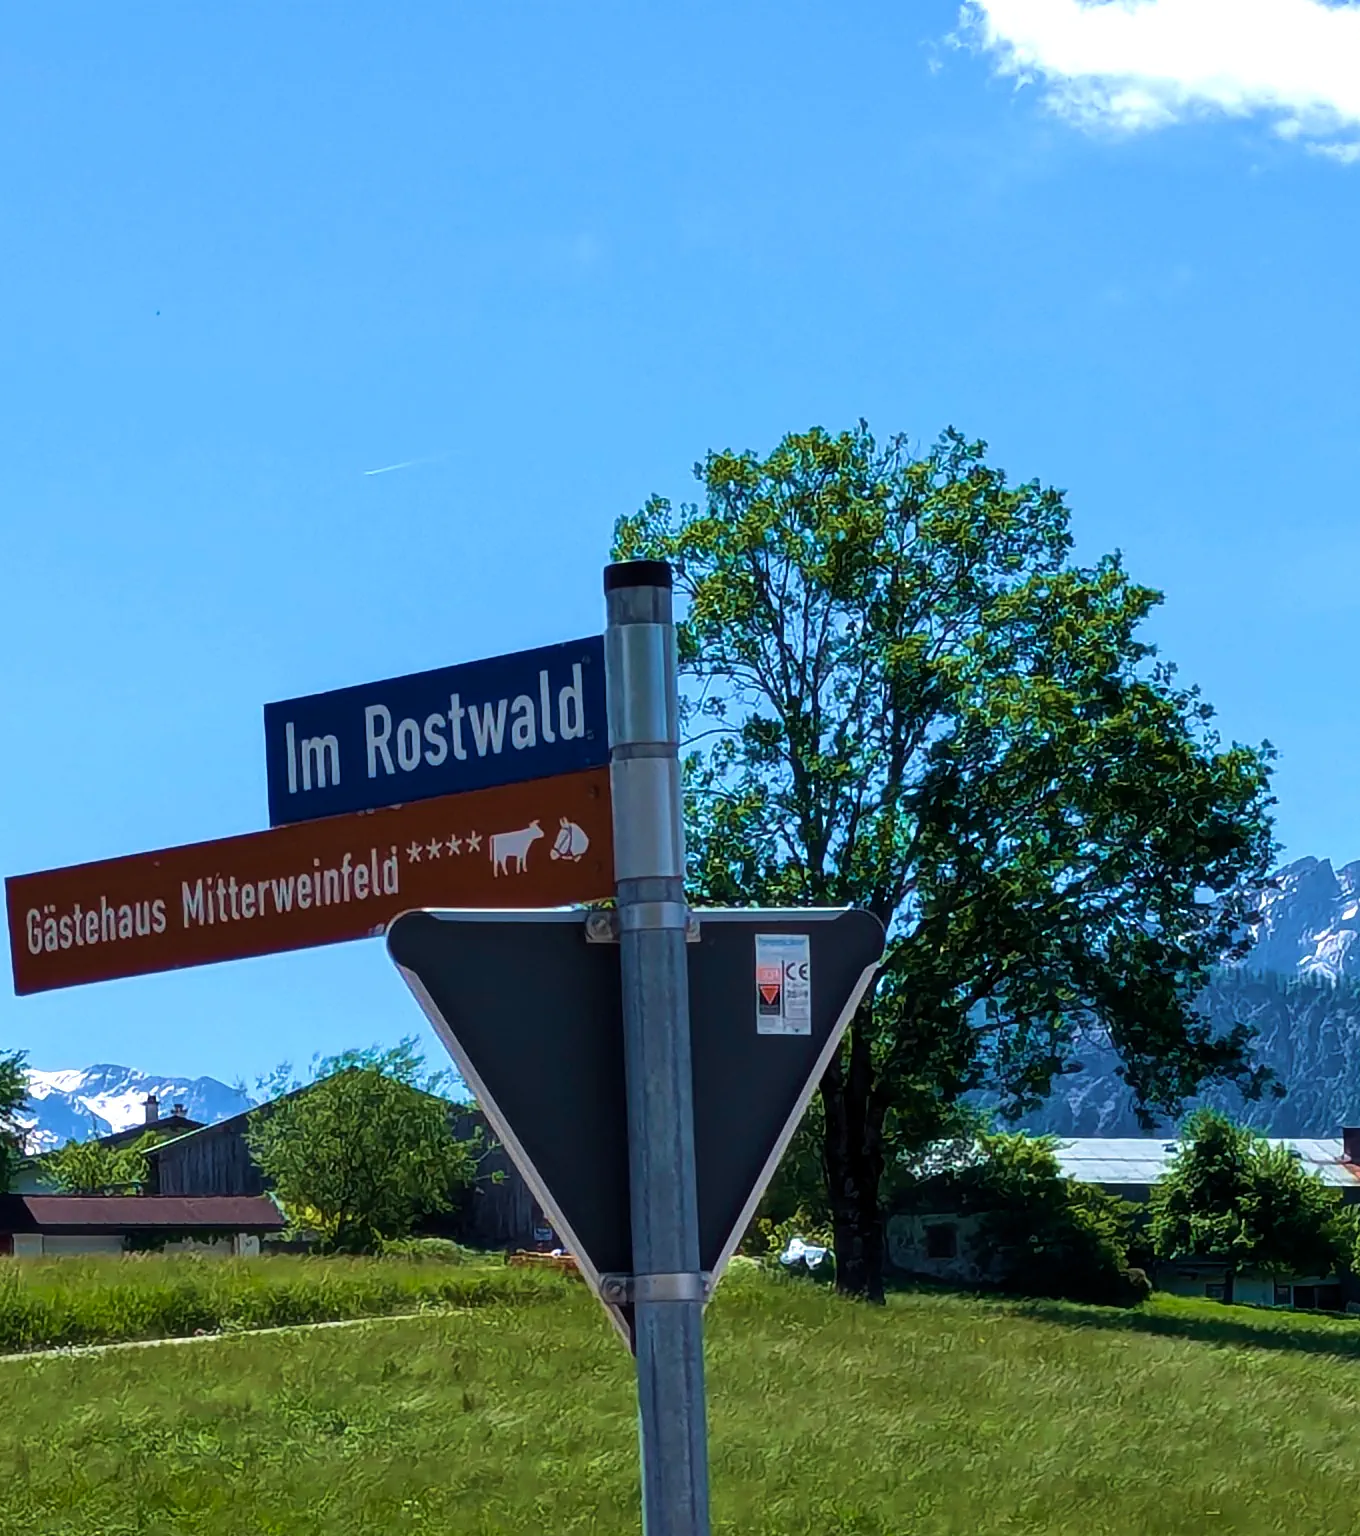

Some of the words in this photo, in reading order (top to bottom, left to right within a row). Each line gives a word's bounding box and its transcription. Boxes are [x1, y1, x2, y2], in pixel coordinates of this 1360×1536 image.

[284, 721, 341, 794] Im
[365, 662, 586, 779] Rostwald
[26, 898, 167, 956] Gästehaus
